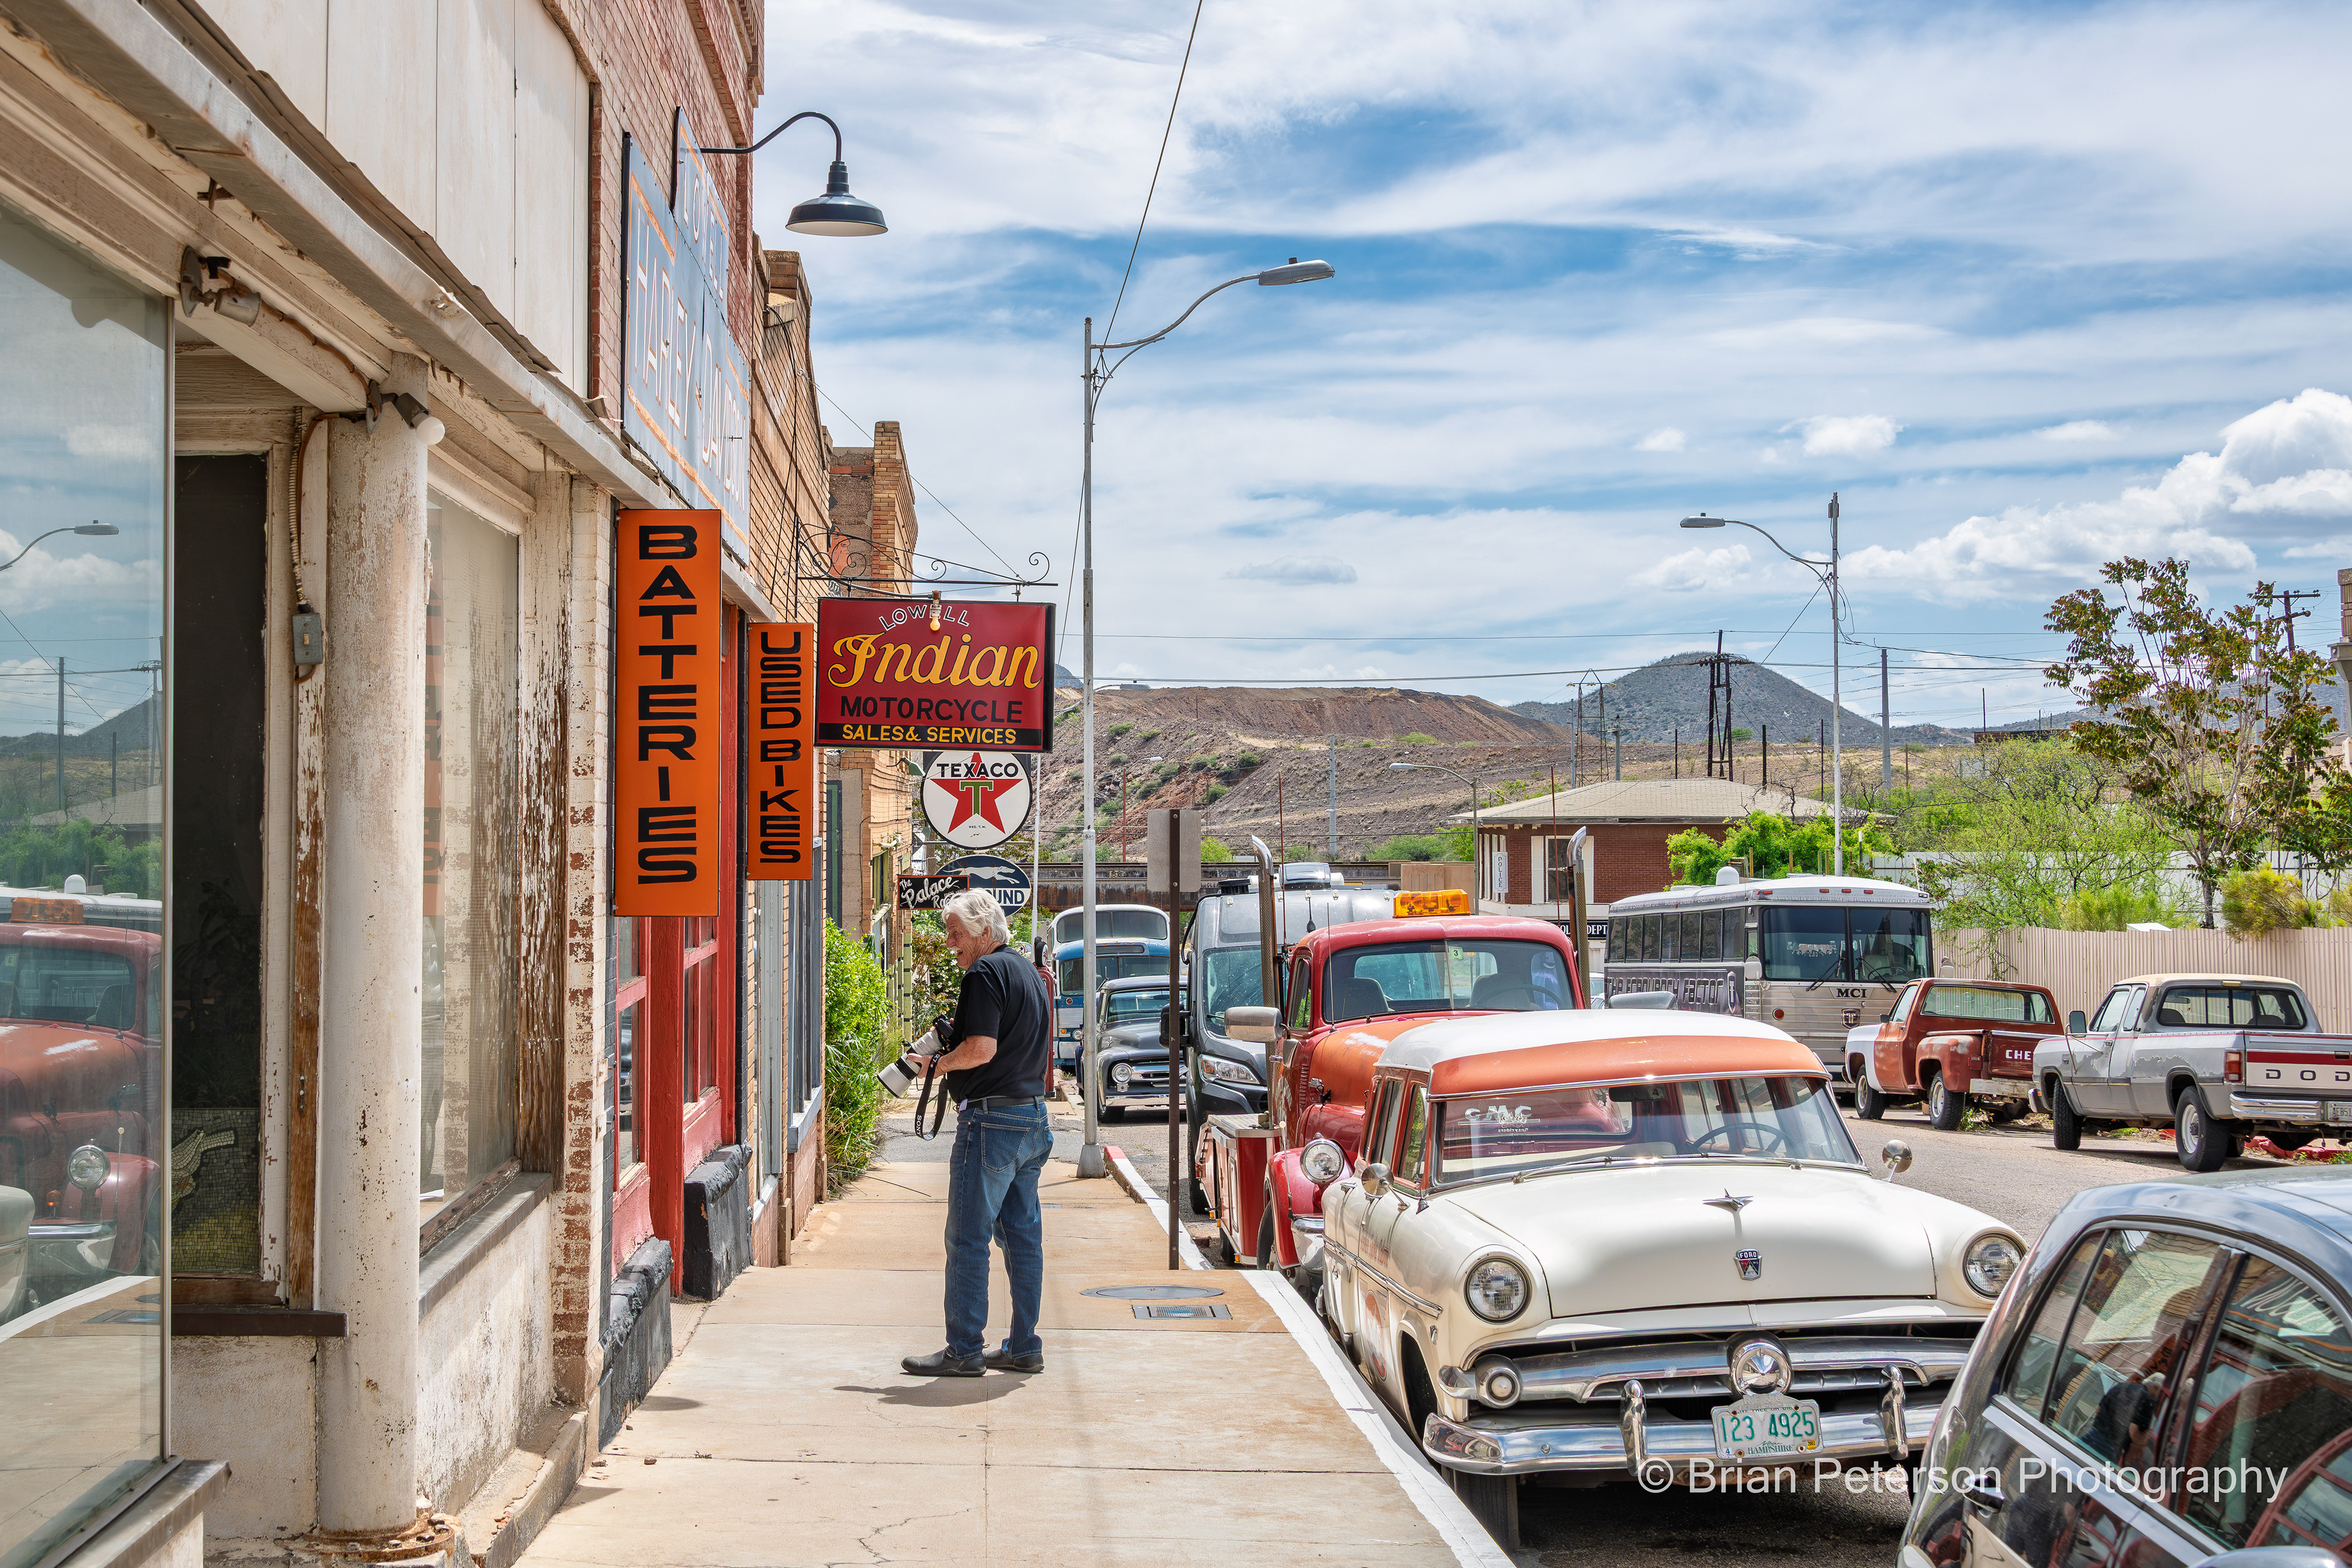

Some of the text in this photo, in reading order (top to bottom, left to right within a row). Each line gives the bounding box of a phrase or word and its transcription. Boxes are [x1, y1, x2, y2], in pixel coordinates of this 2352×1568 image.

[682, 147, 724, 303] LOWELL
[827, 631, 1042, 689] Indian
[638, 525, 698, 885] BATTERIES
[840, 696, 1023, 724] MOTORCYCLE
[760, 631, 801, 864] USED BIKES
[927, 726, 1017, 745] SERVICES
[936, 762, 1019, 778] TEXACO
[959, 780, 994, 816] T
[899, 878, 913, 891] The
[900, 876, 960, 910] Palace
[1836, 988, 1867, 998] MCI
[2005, 1049, 2032, 1060] CHE
[1721, 1411, 1815, 1442] 123 4925
[1747, 1444, 1793, 1455] HAMPSHIRE
